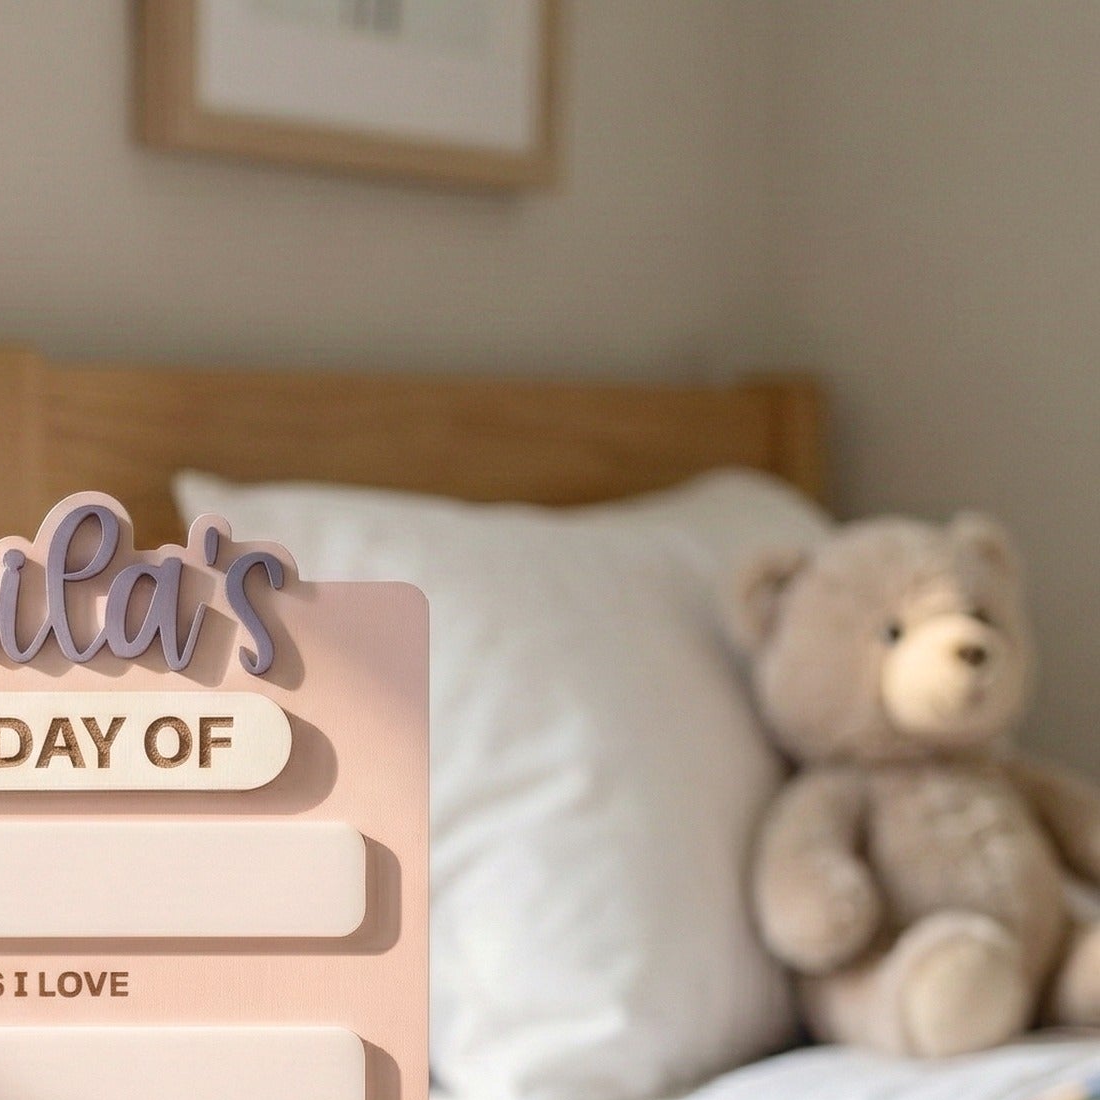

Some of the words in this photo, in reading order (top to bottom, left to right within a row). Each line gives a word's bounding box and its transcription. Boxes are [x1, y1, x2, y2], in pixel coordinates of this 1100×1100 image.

[143, 716, 234, 769] OF
[14, 971, 28, 998] I
[38, 971, 129, 998] LOVE
